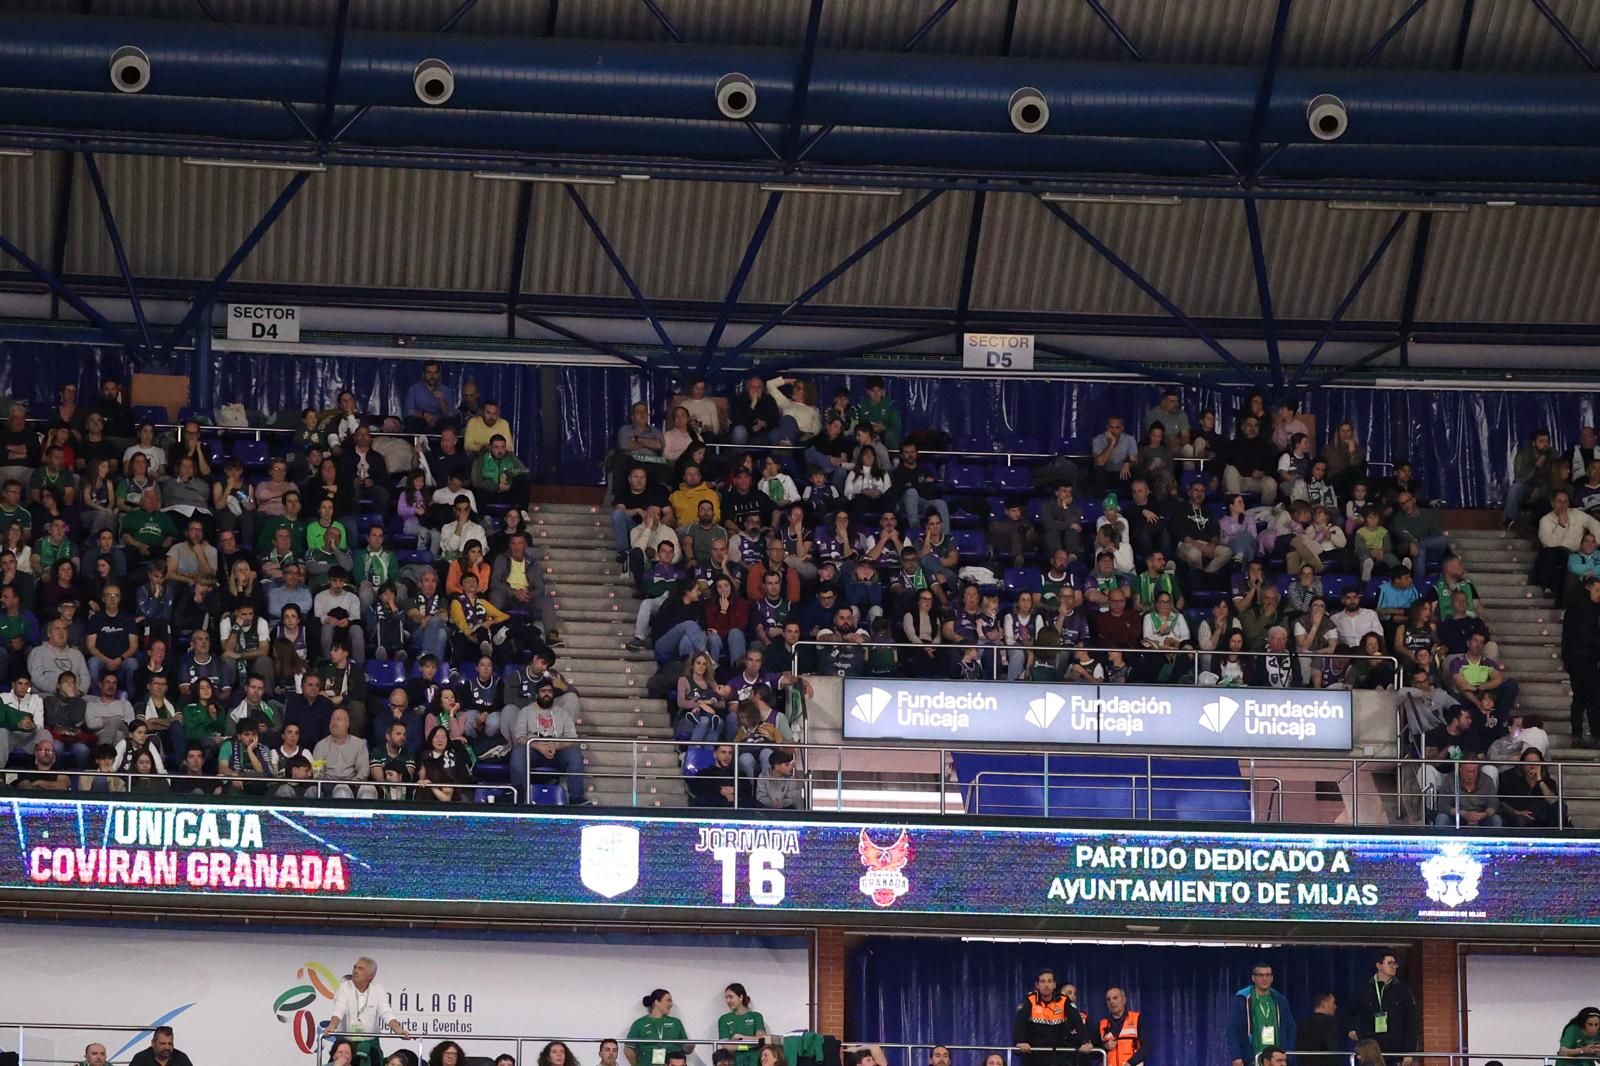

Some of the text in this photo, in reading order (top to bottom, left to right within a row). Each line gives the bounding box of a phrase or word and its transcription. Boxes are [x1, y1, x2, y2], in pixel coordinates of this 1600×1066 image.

[233, 306, 296, 320] SECTOR
[251, 322, 279, 339] D4
[968, 335, 1030, 349] SECTOR
[986, 351, 1013, 368] D5
[897, 690, 997, 710] Fundación
[1071, 695, 1171, 715] Fundación
[1244, 699, 1344, 719] Fundación
[897, 708, 970, 731] Unicaja
[1071, 713, 1144, 736] Unicaja
[1244, 717, 1317, 740] Unicaja
[114, 810, 264, 848] UNICAJA
[695, 828, 800, 854] JORNADA
[30, 847, 346, 891] COVIRAN GRANADA
[1076, 845, 1350, 873] PARTIDO DEDICADO A
[713, 848, 786, 905] 16
[1047, 877, 1379, 906] AYUNTAMIENTO DE MIJAS
[422, 1021, 428, 1035] y
[432, 1018, 472, 1033] Eventos
